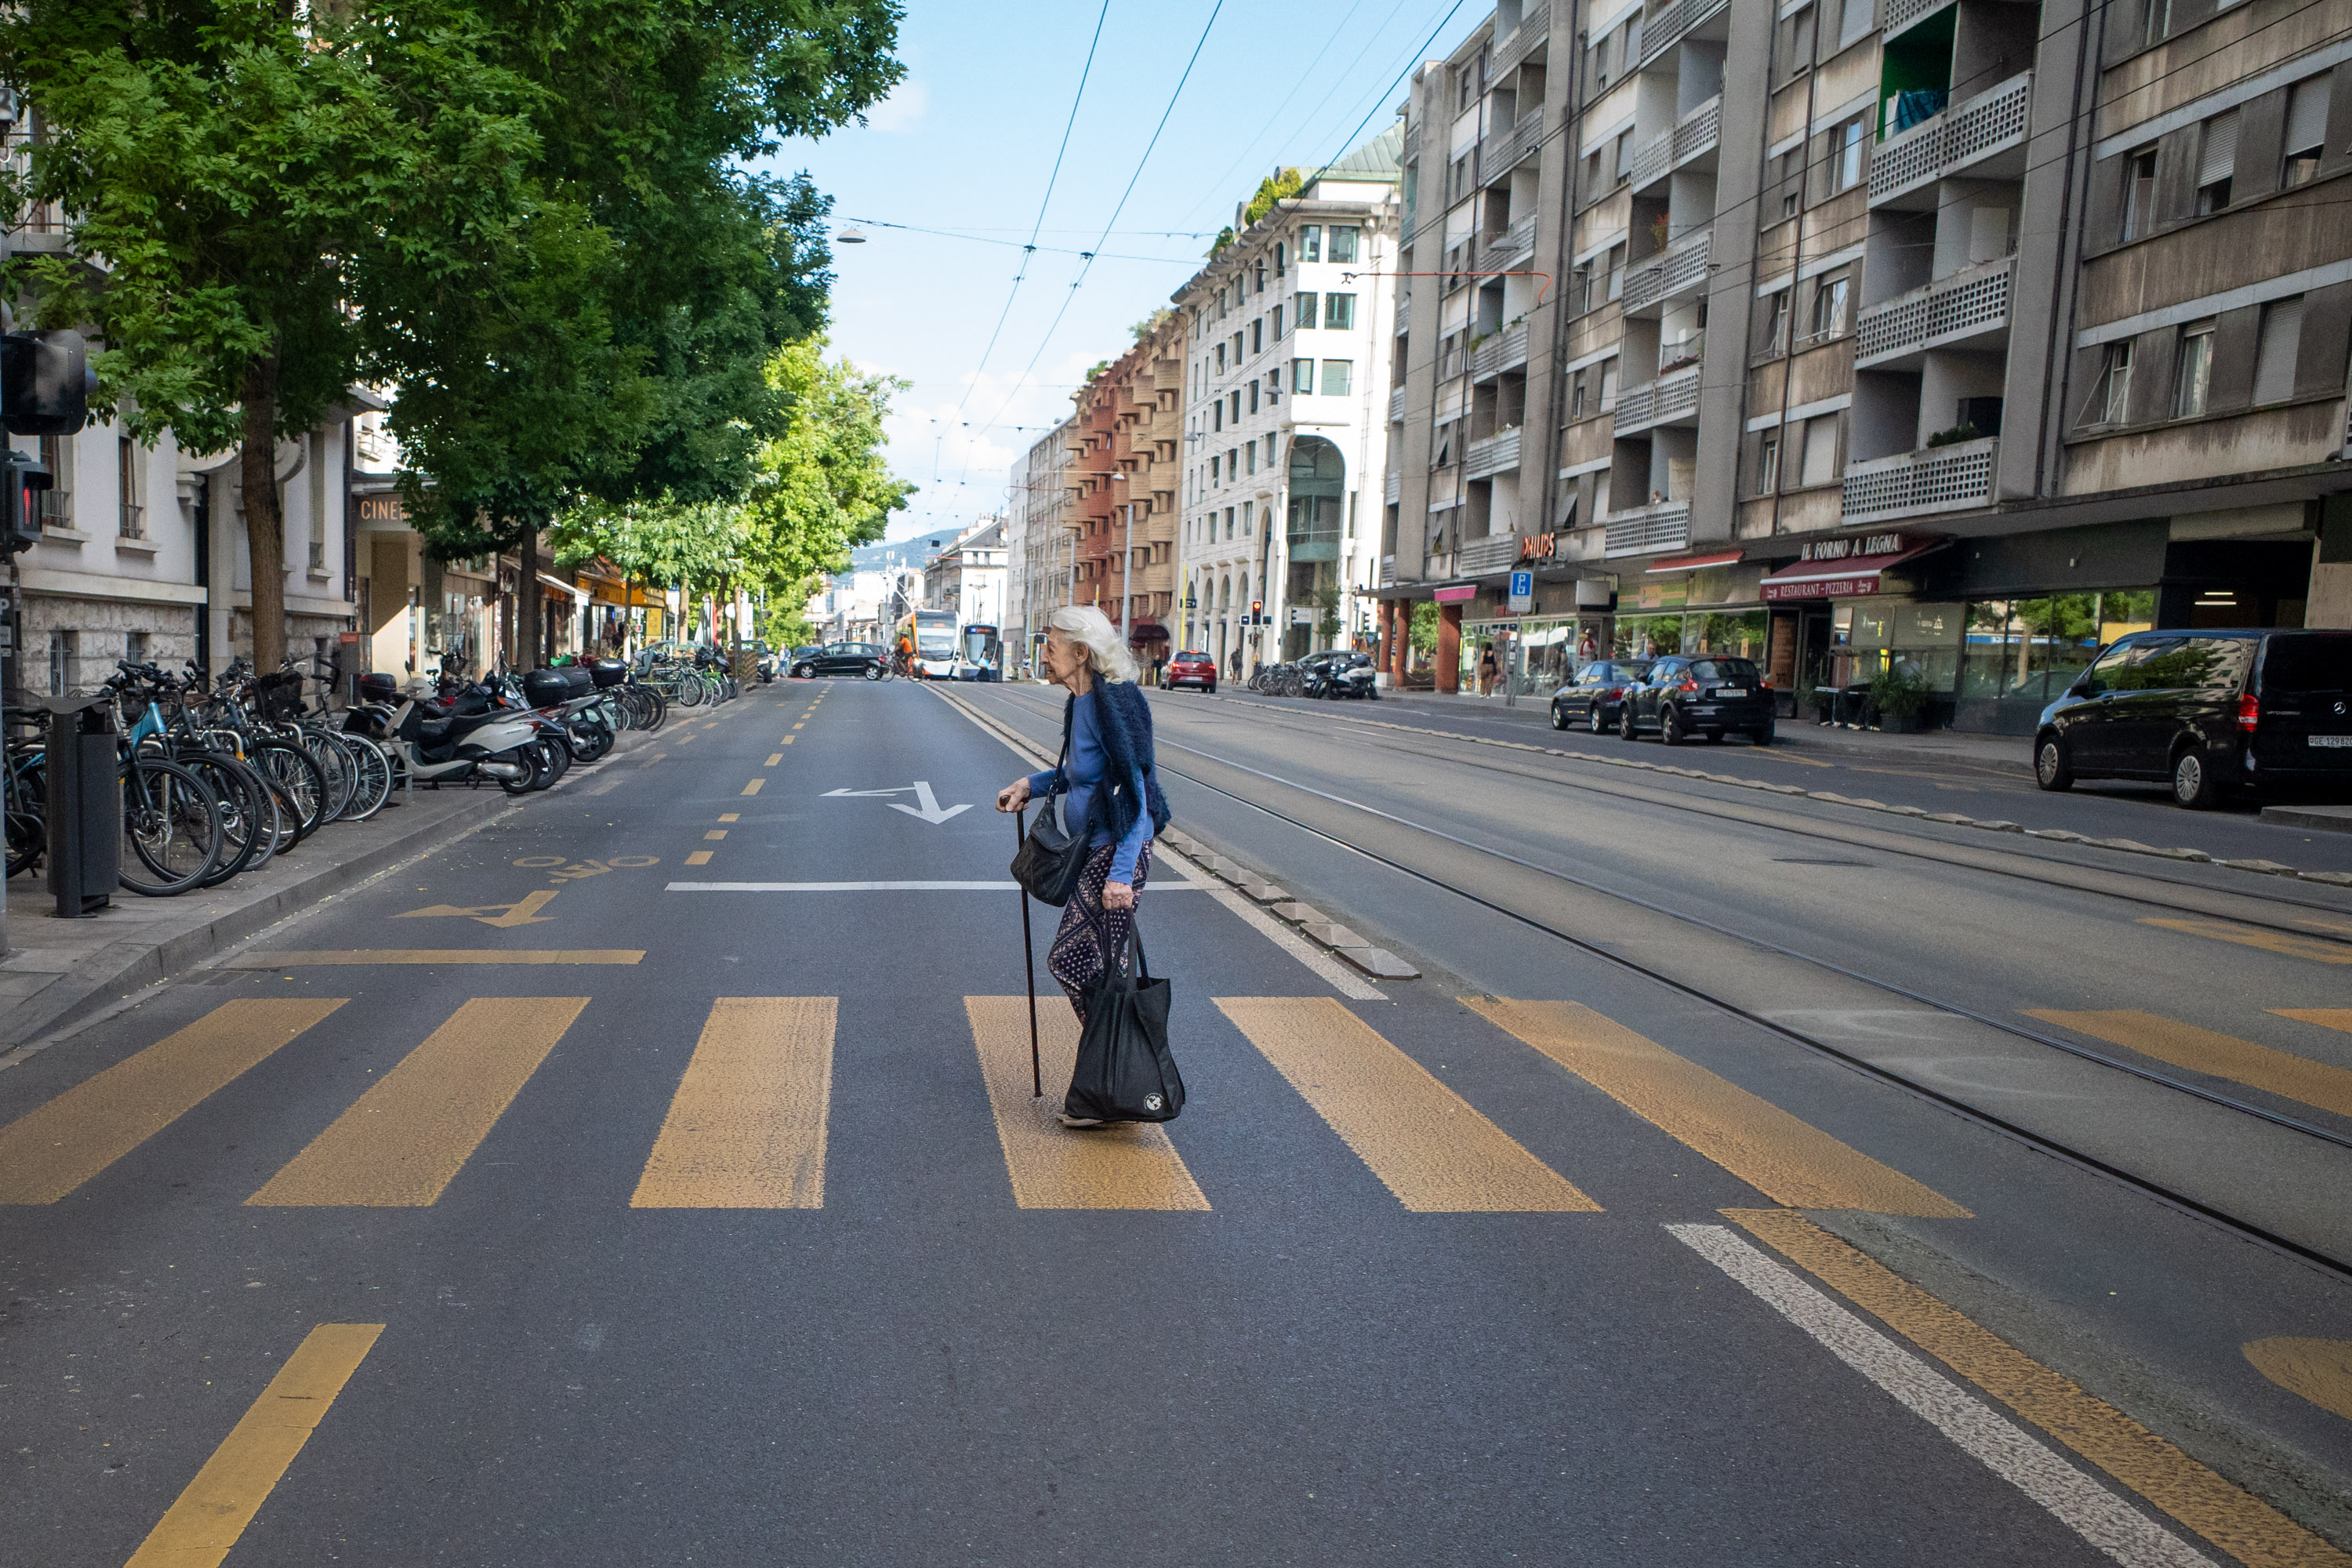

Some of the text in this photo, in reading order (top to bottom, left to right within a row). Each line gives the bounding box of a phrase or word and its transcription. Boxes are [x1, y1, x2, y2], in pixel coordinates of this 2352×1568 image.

[1522, 532, 1555, 559] PHILIPS
[1802, 534, 1900, 561] IL FORNO A LEGNA
[1780, 583, 1820, 597] RESTAURANT
[1825, 581, 1853, 594] PIZZERIA
[2314, 737, 2324, 746] GE
